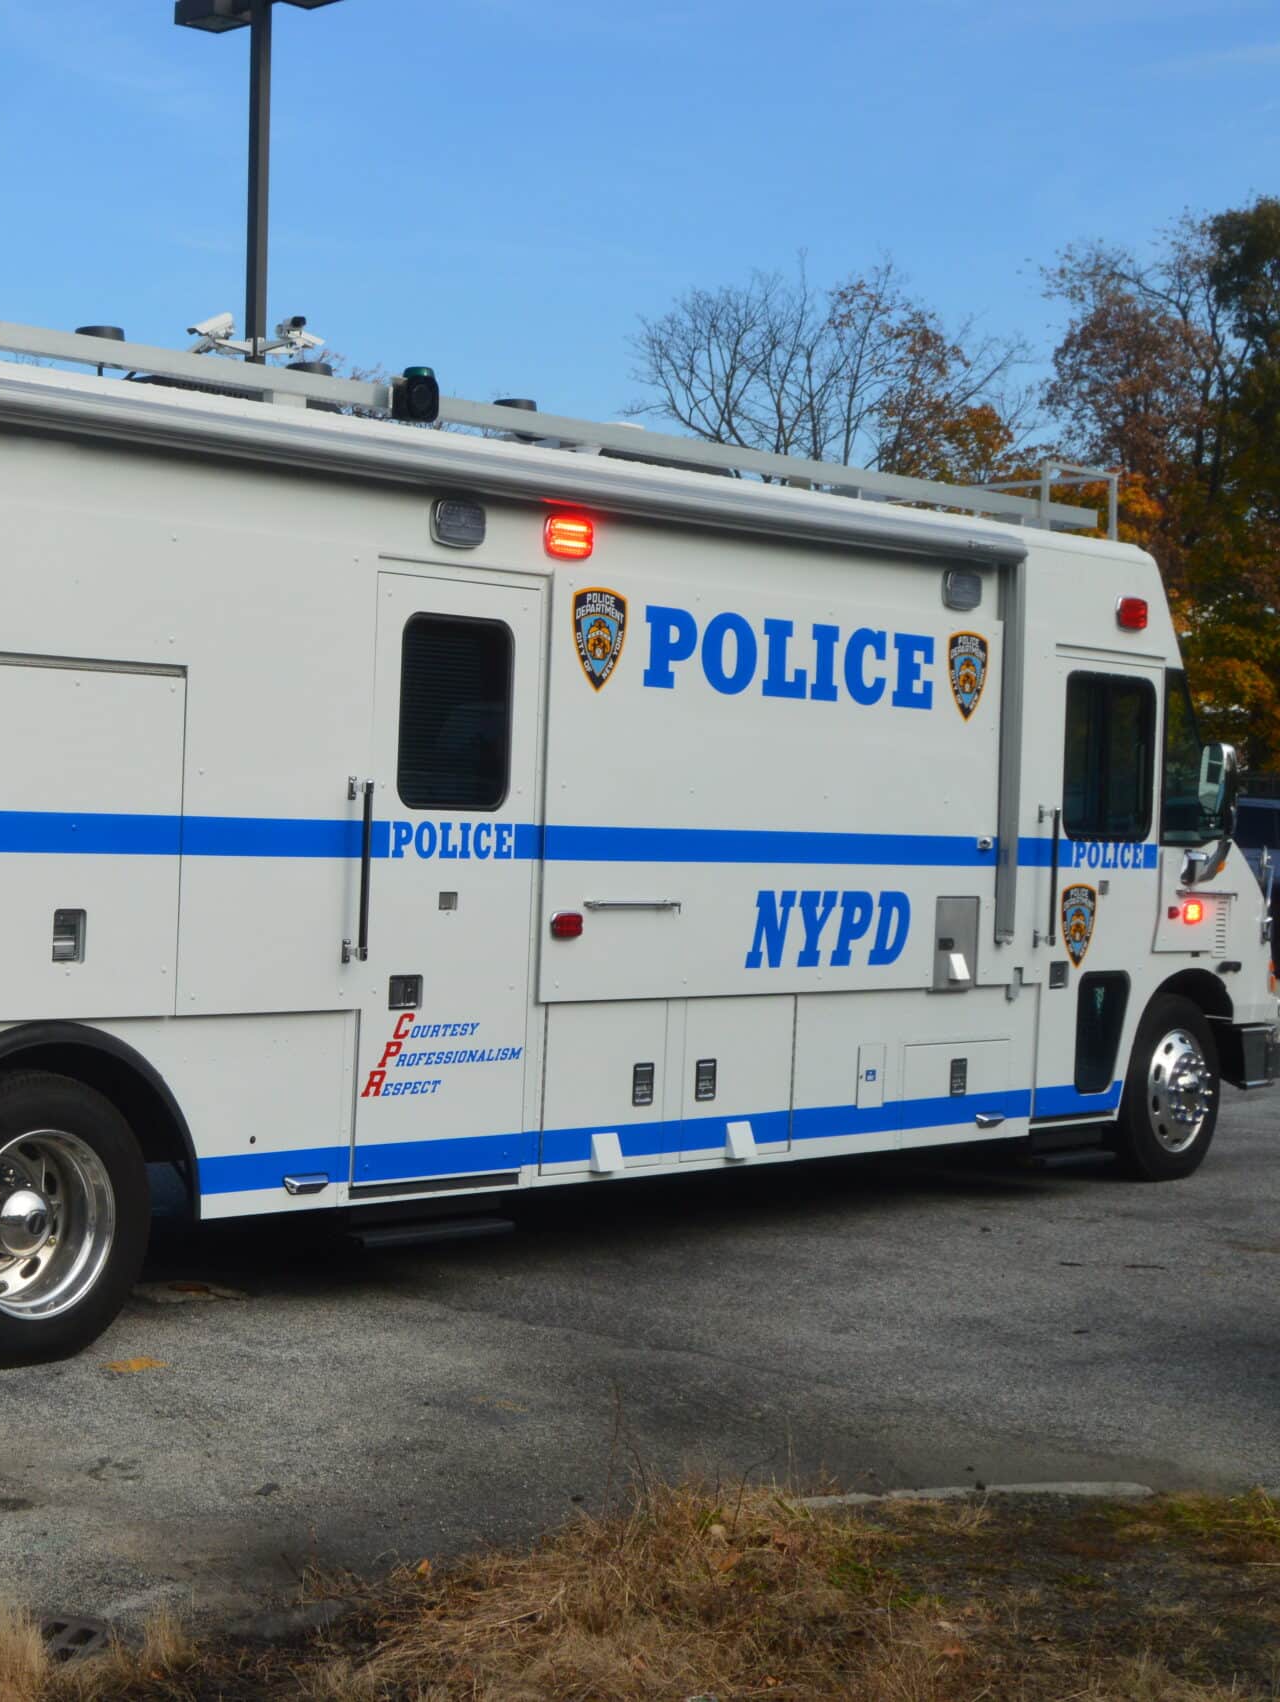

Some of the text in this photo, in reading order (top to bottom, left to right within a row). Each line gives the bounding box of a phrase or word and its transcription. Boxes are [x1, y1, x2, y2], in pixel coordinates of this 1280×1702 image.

[576, 603, 624, 624] DEPARTMENT
[586, 592, 616, 607] POLICE
[643, 605, 934, 711] POLICE
[392, 821, 512, 860] POLICE
[1073, 842, 1143, 869] POLICE
[744, 890, 911, 968] NYPD
